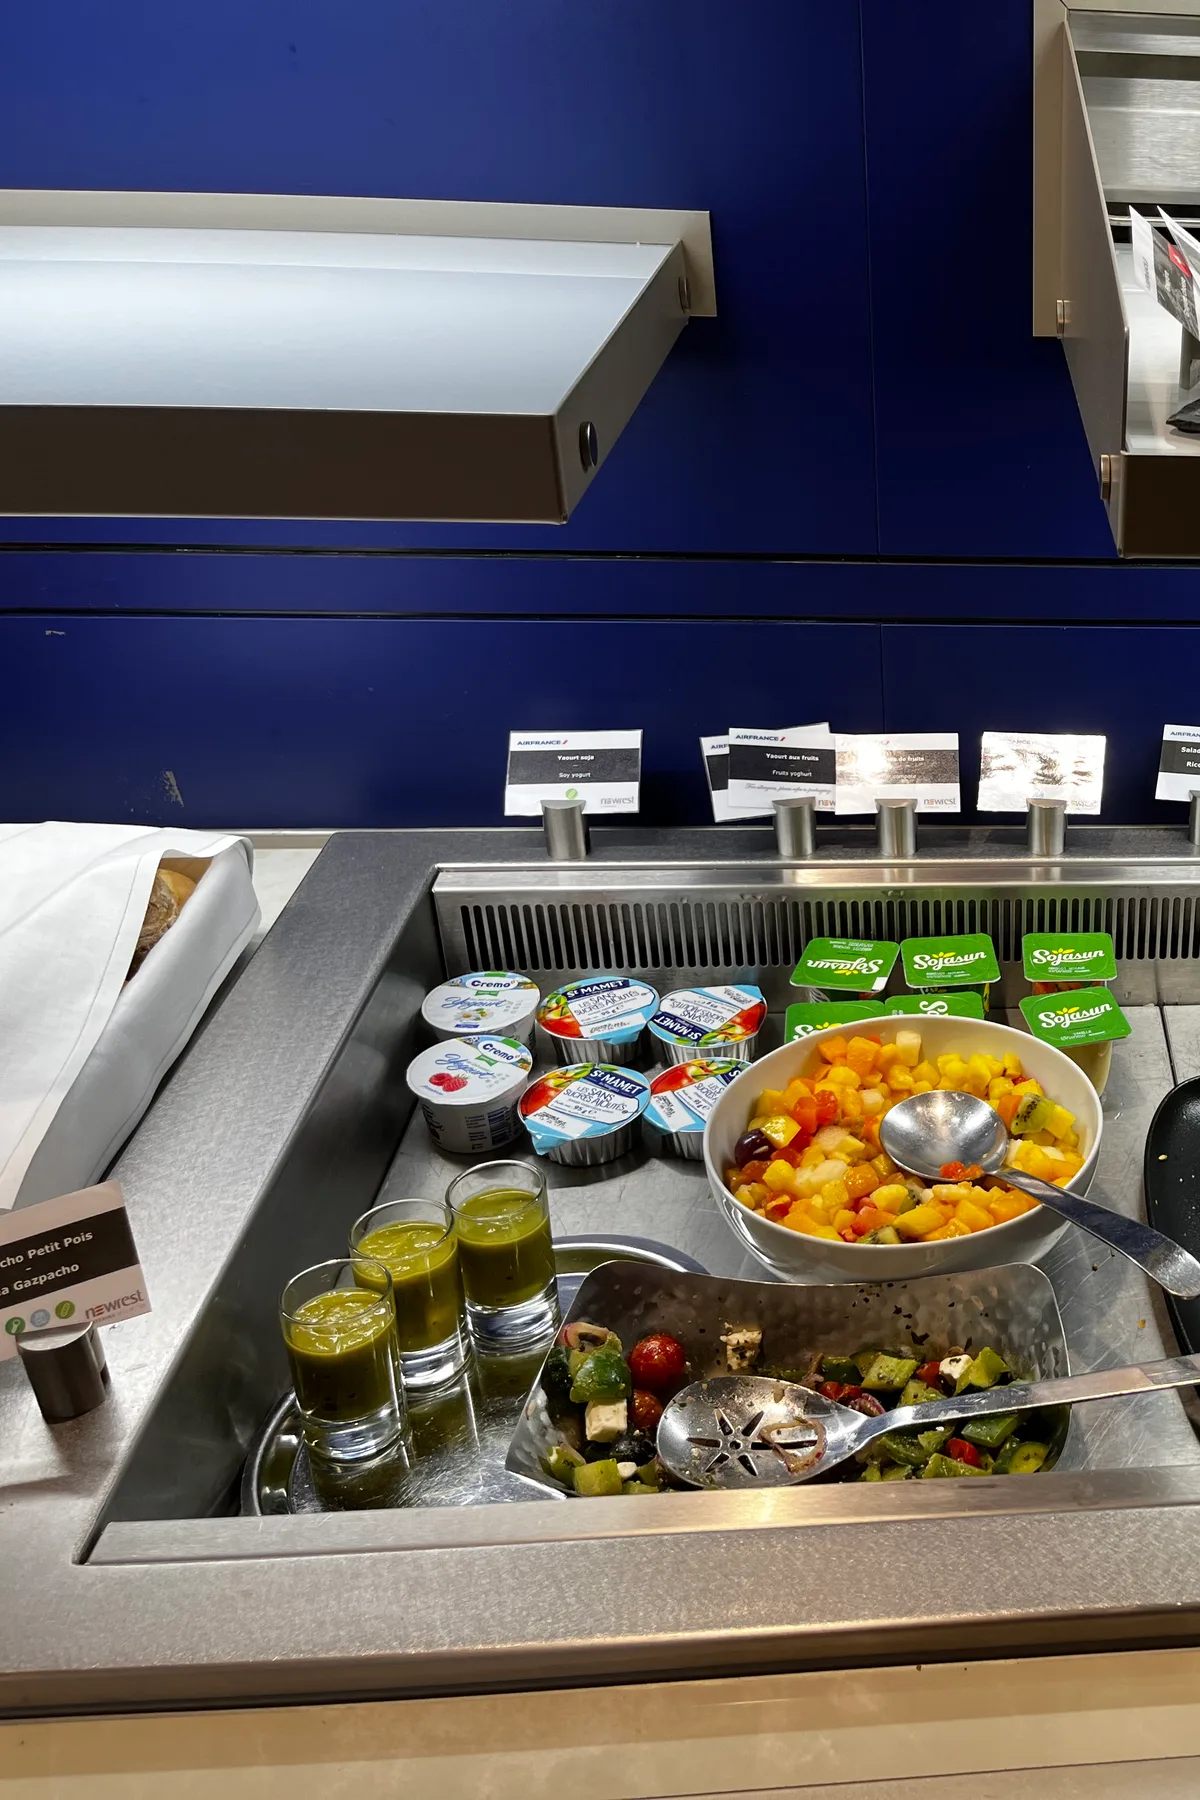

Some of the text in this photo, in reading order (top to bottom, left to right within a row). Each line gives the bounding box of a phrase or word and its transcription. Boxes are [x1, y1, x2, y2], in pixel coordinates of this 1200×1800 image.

[801, 754, 819, 762] fruits
[790, 770, 813, 778] yoghurt
[600, 796, 635, 804] newrest
[923, 797, 956, 805] newrest
[806, 957, 884, 974] Sojasun
[913, 951, 987, 971] Sojasun
[1032, 949, 1105, 966] Sojasun
[470, 980, 511, 988] Cremo
[580, 980, 625, 994] MAMET
[590, 991, 617, 1003] SANS
[1038, 1003, 1113, 1028] Sojasun
[654, 1015, 693, 1037] MAMET
[482, 1043, 514, 1061] Cremo
[602, 1073, 643, 1095] MAMET
[588, 1087, 616, 1101] SANS
[27, 1231, 94, 1259] Petit Pois
[13, 1263, 80, 1291] Gazpacho
[84, 1289, 145, 1320] newrest
